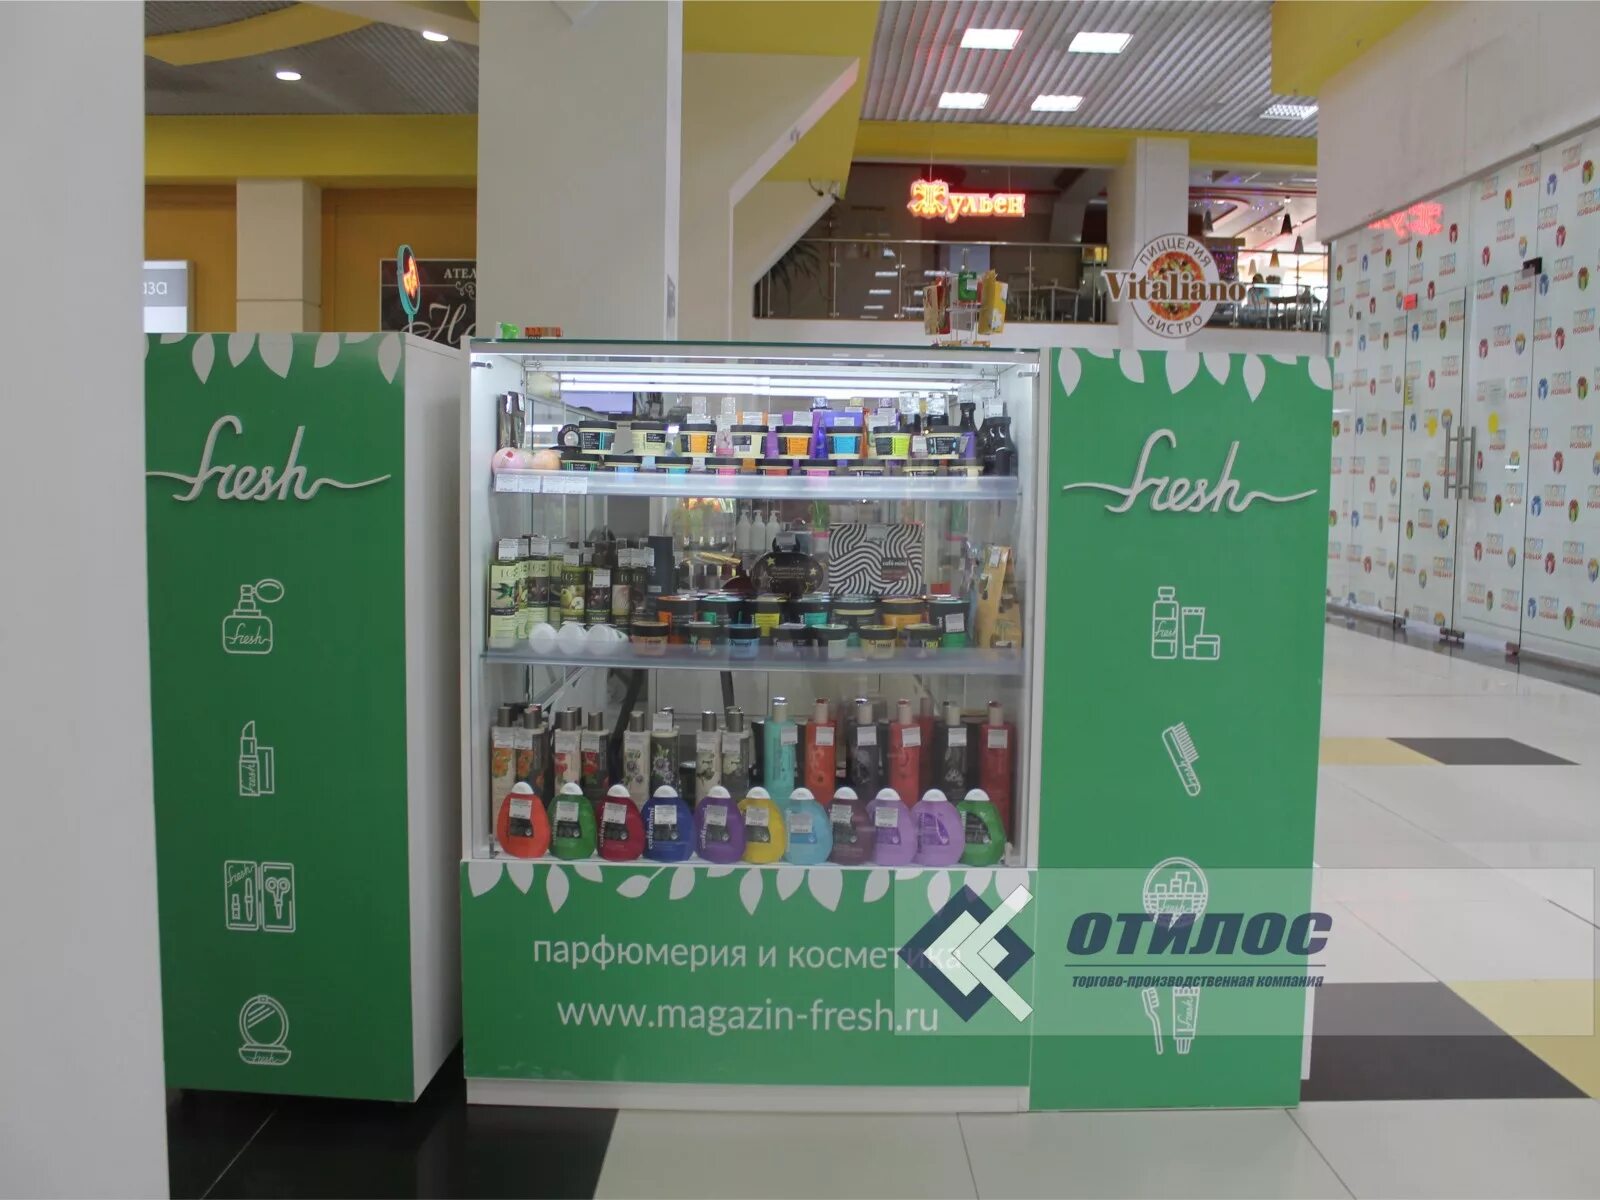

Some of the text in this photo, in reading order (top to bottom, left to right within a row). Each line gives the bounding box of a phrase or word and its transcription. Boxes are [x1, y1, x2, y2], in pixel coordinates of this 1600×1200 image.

[907, 179, 1026, 223] Жульен
[1139, 236, 1212, 267] ПИЦЦЕРИЯ
[1103, 271, 1246, 302] Vitaliano
[1147, 314, 1203, 335] БИСТРО
[146, 415, 391, 501] fresh
[1063, 429, 1318, 513] fresh
[533, 934, 747, 972] парфюмерия
[758, 947, 778, 968] и
[557, 998, 939, 1036] www.magazin-fresh.ru
